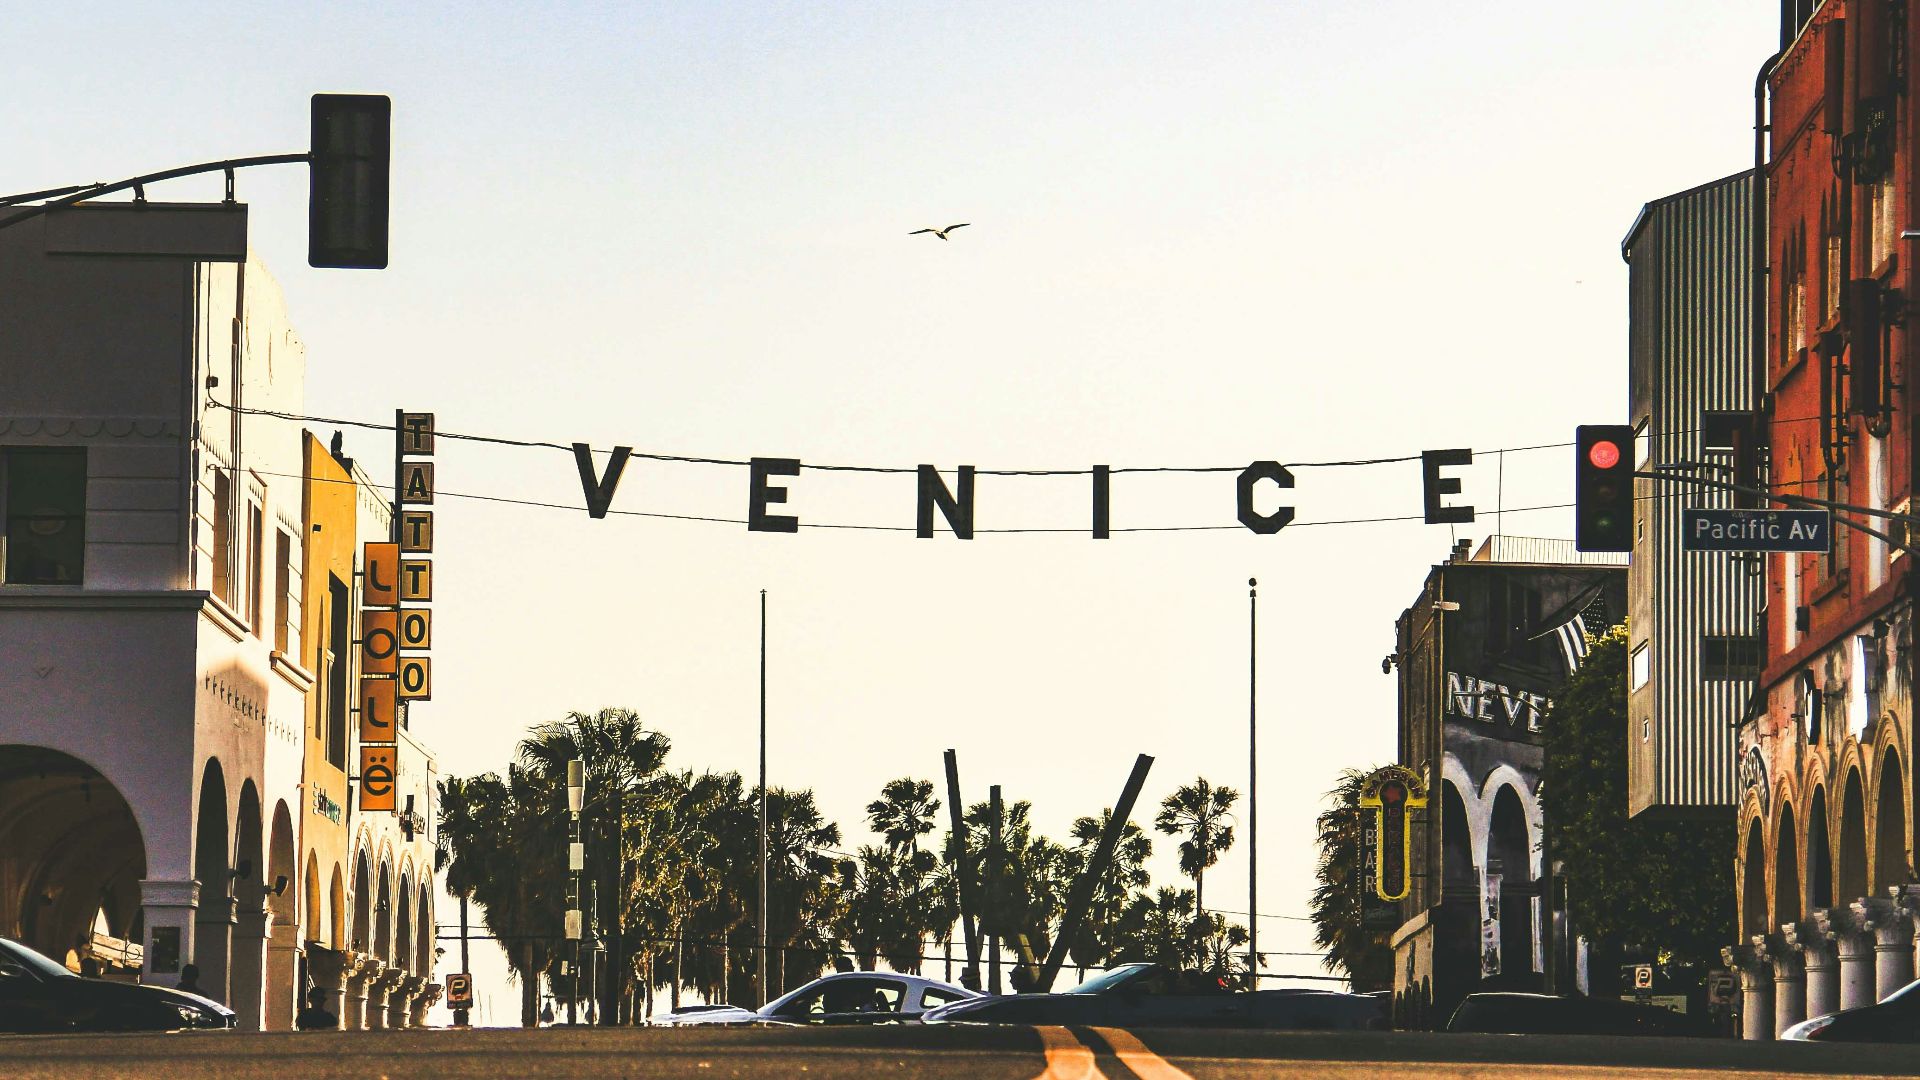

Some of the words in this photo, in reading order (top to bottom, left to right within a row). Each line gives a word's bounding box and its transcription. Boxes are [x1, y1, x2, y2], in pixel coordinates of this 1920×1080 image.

[572, 443, 1475, 540] VENICE
[403, 417, 429, 694] TATTOO
[1696, 518, 1780, 539] Pacific
[1789, 519, 1818, 540] Av
[1446, 671, 1554, 733] NEVE
[1365, 828, 1375, 893] BAR
